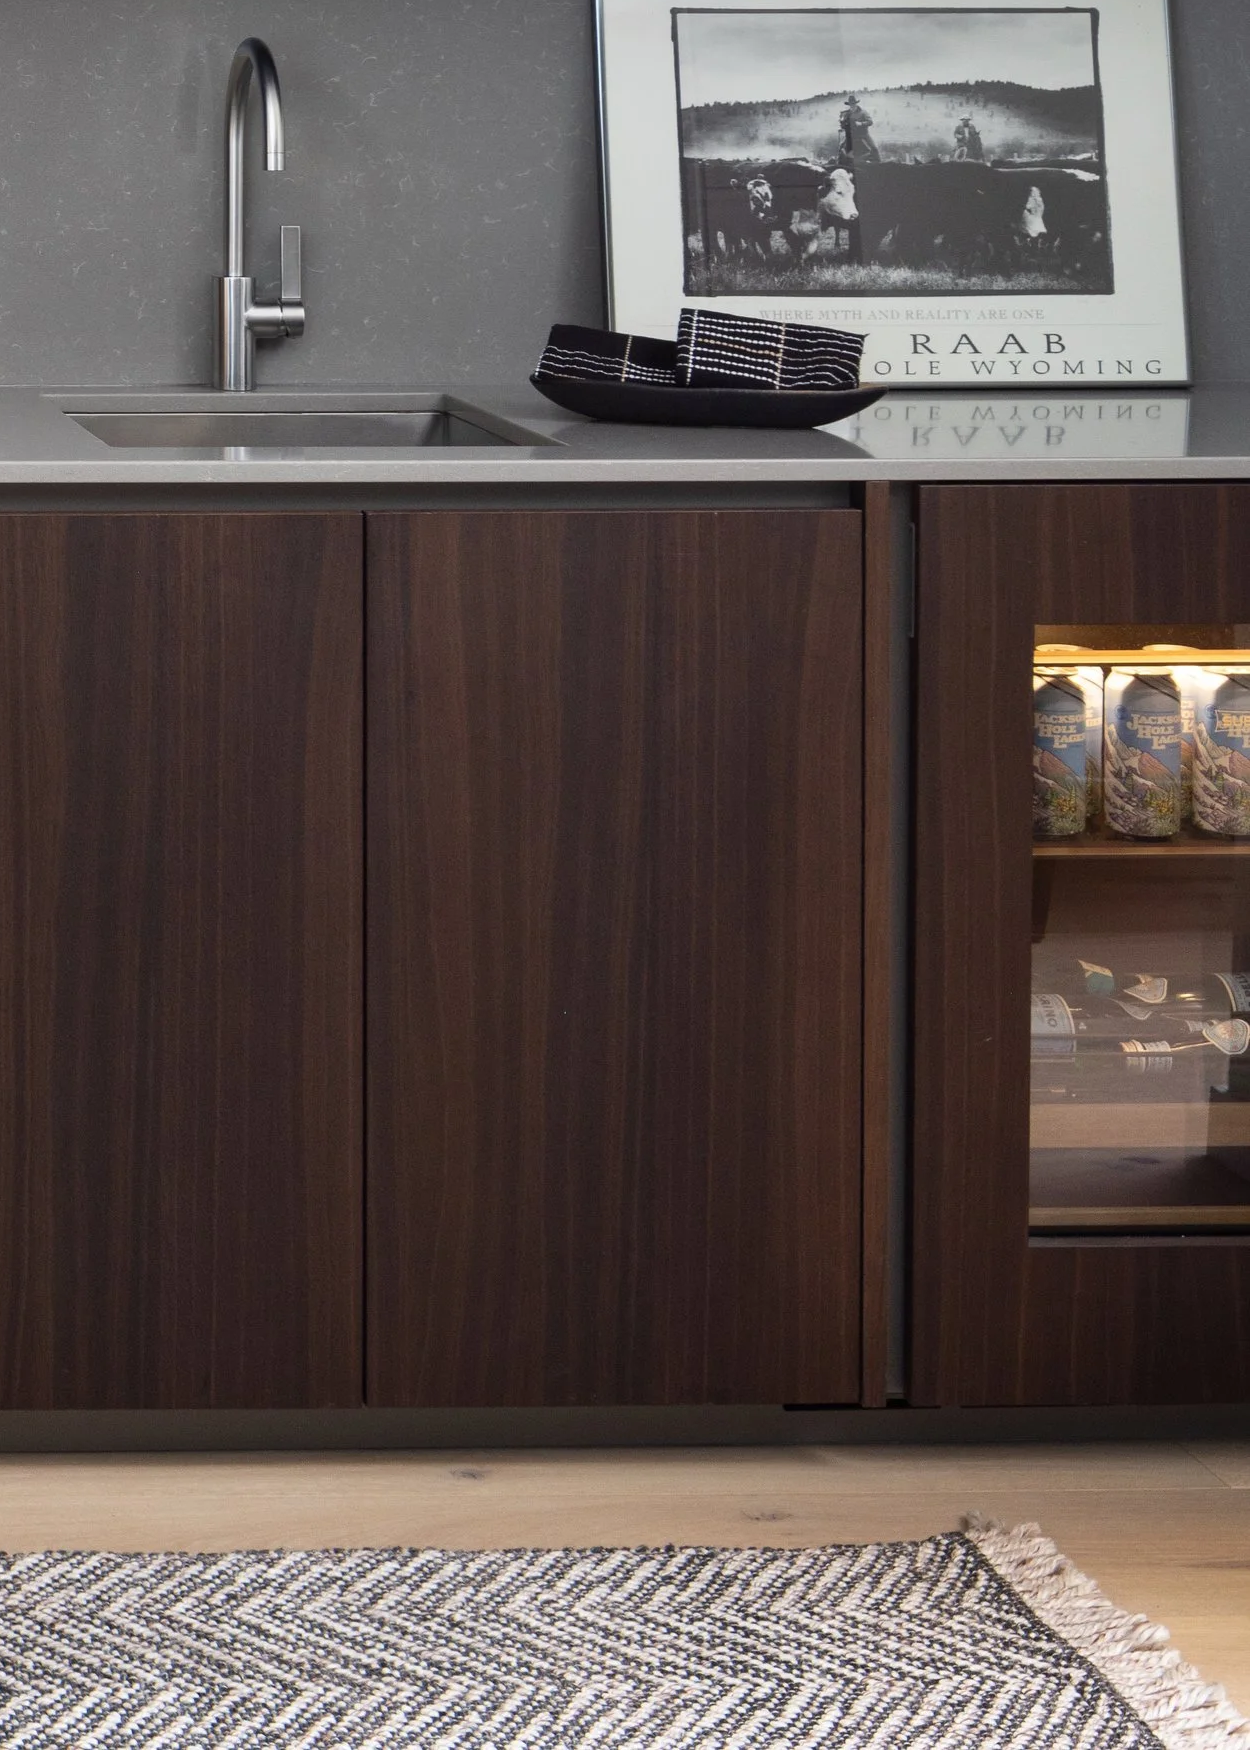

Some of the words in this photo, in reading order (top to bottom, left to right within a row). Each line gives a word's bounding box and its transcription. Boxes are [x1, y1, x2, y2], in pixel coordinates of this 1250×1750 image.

[759, 309, 813, 320] WHERE
[818, 309, 862, 320] MYTH
[867, 309, 900, 320] AND
[905, 309, 971, 320] REALITY
[977, 309, 1008, 320] ARE
[1012, 309, 1045, 320] ONE
[909, 333, 1066, 354] RAAB
[874, 360, 941, 375] OLE
[970, 360, 1162, 375] WYOMING
[1126, 713, 1182, 730] JACKSO
[1038, 723, 1077, 738] HOLE
[1137, 724, 1175, 738] HOLE
